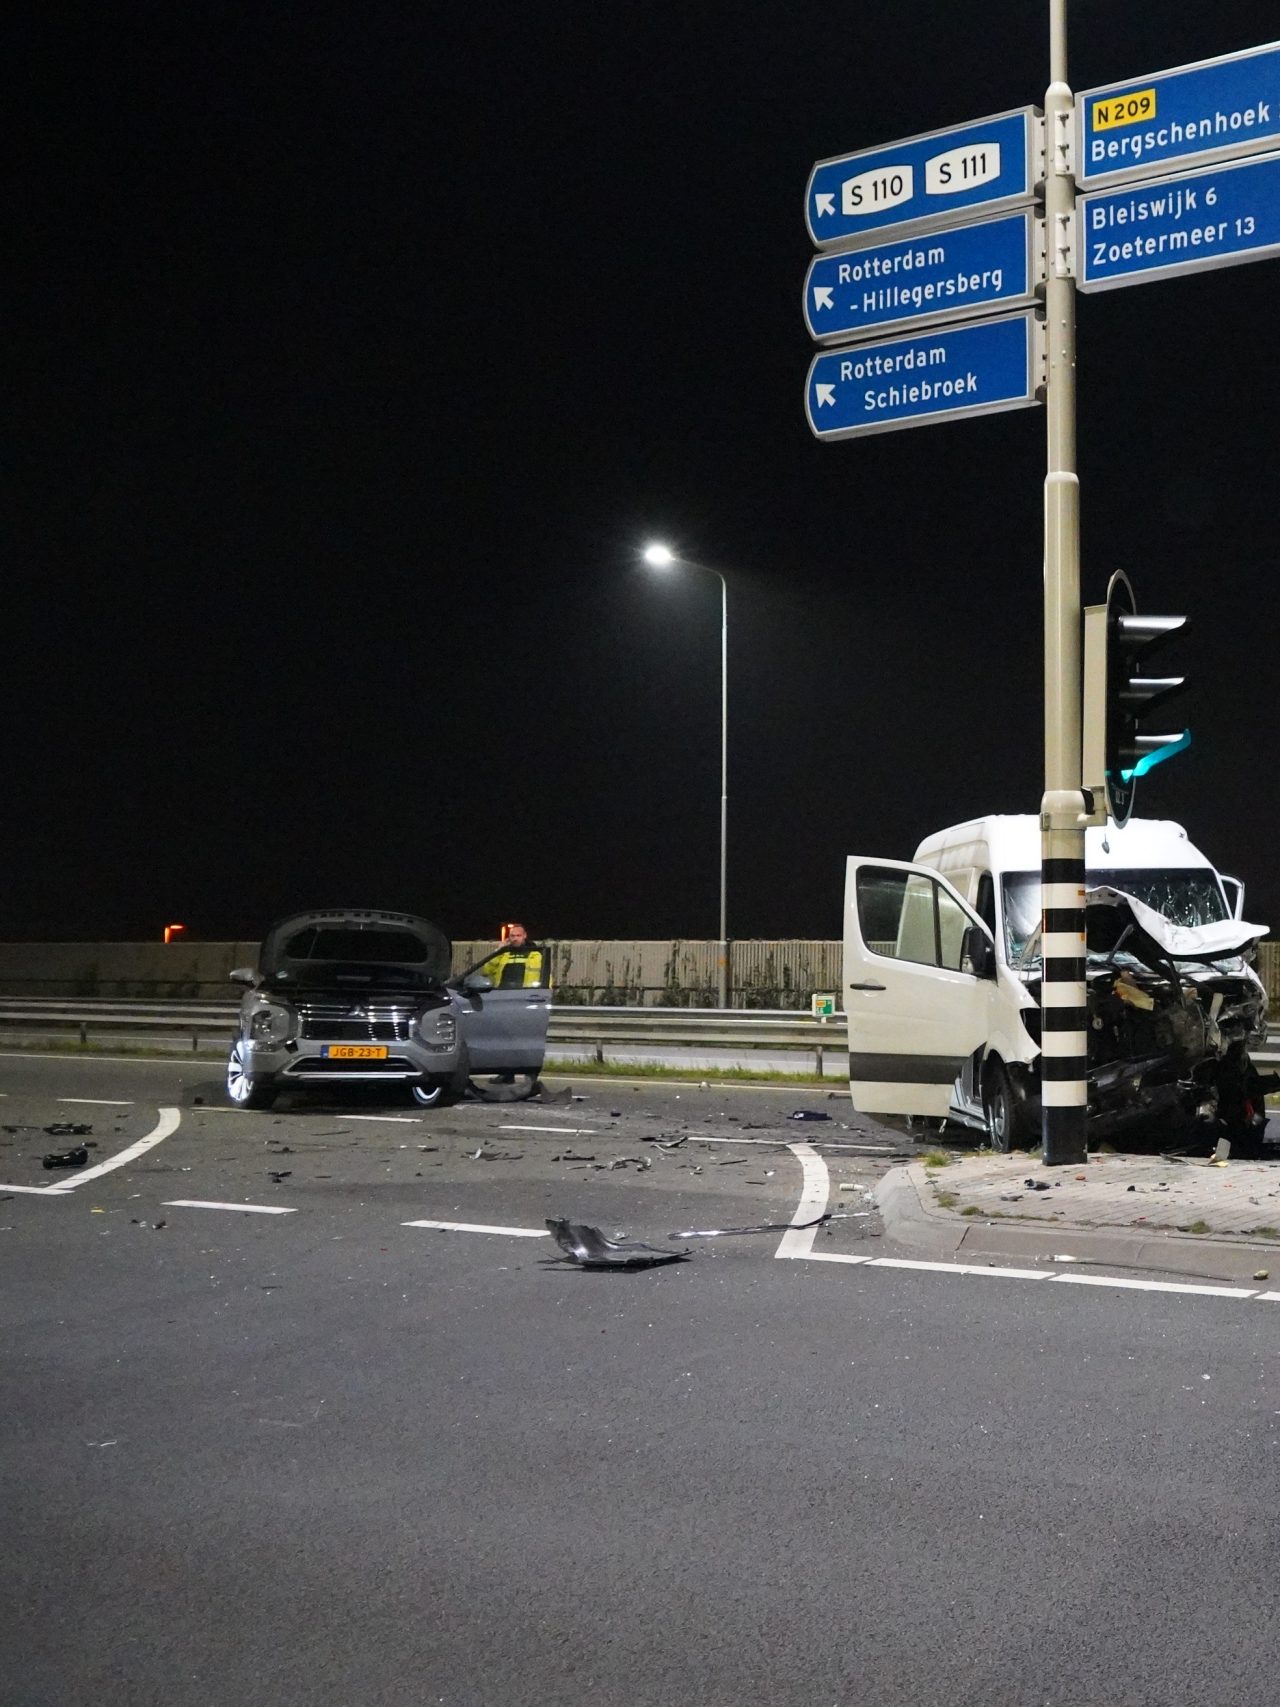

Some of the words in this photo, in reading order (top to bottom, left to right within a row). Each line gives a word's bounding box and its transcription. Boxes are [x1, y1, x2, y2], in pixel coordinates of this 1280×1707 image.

[1097, 107, 1109, 125] N
[1114, 96, 1151, 121] 209
[1091, 101, 1270, 162] Bergschenhoek
[939, 162, 953, 185] S
[961, 153, 987, 180] 111
[851, 185, 864, 206] S
[872, 174, 903, 201] 110
[1092, 189, 1197, 230] Bleiswijk
[1205, 187, 1217, 206] 6
[1093, 222, 1228, 265] Zoetermeer
[1235, 216, 1256, 237] 13
[838, 246, 945, 285] Rotterdam
[850, 269, 1003, 313] -Hillegersberg
[840, 347, 946, 382] Rotterdam
[864, 372, 978, 411] Schiebroek
[333, 1047, 382, 1057] JGB-23-T
